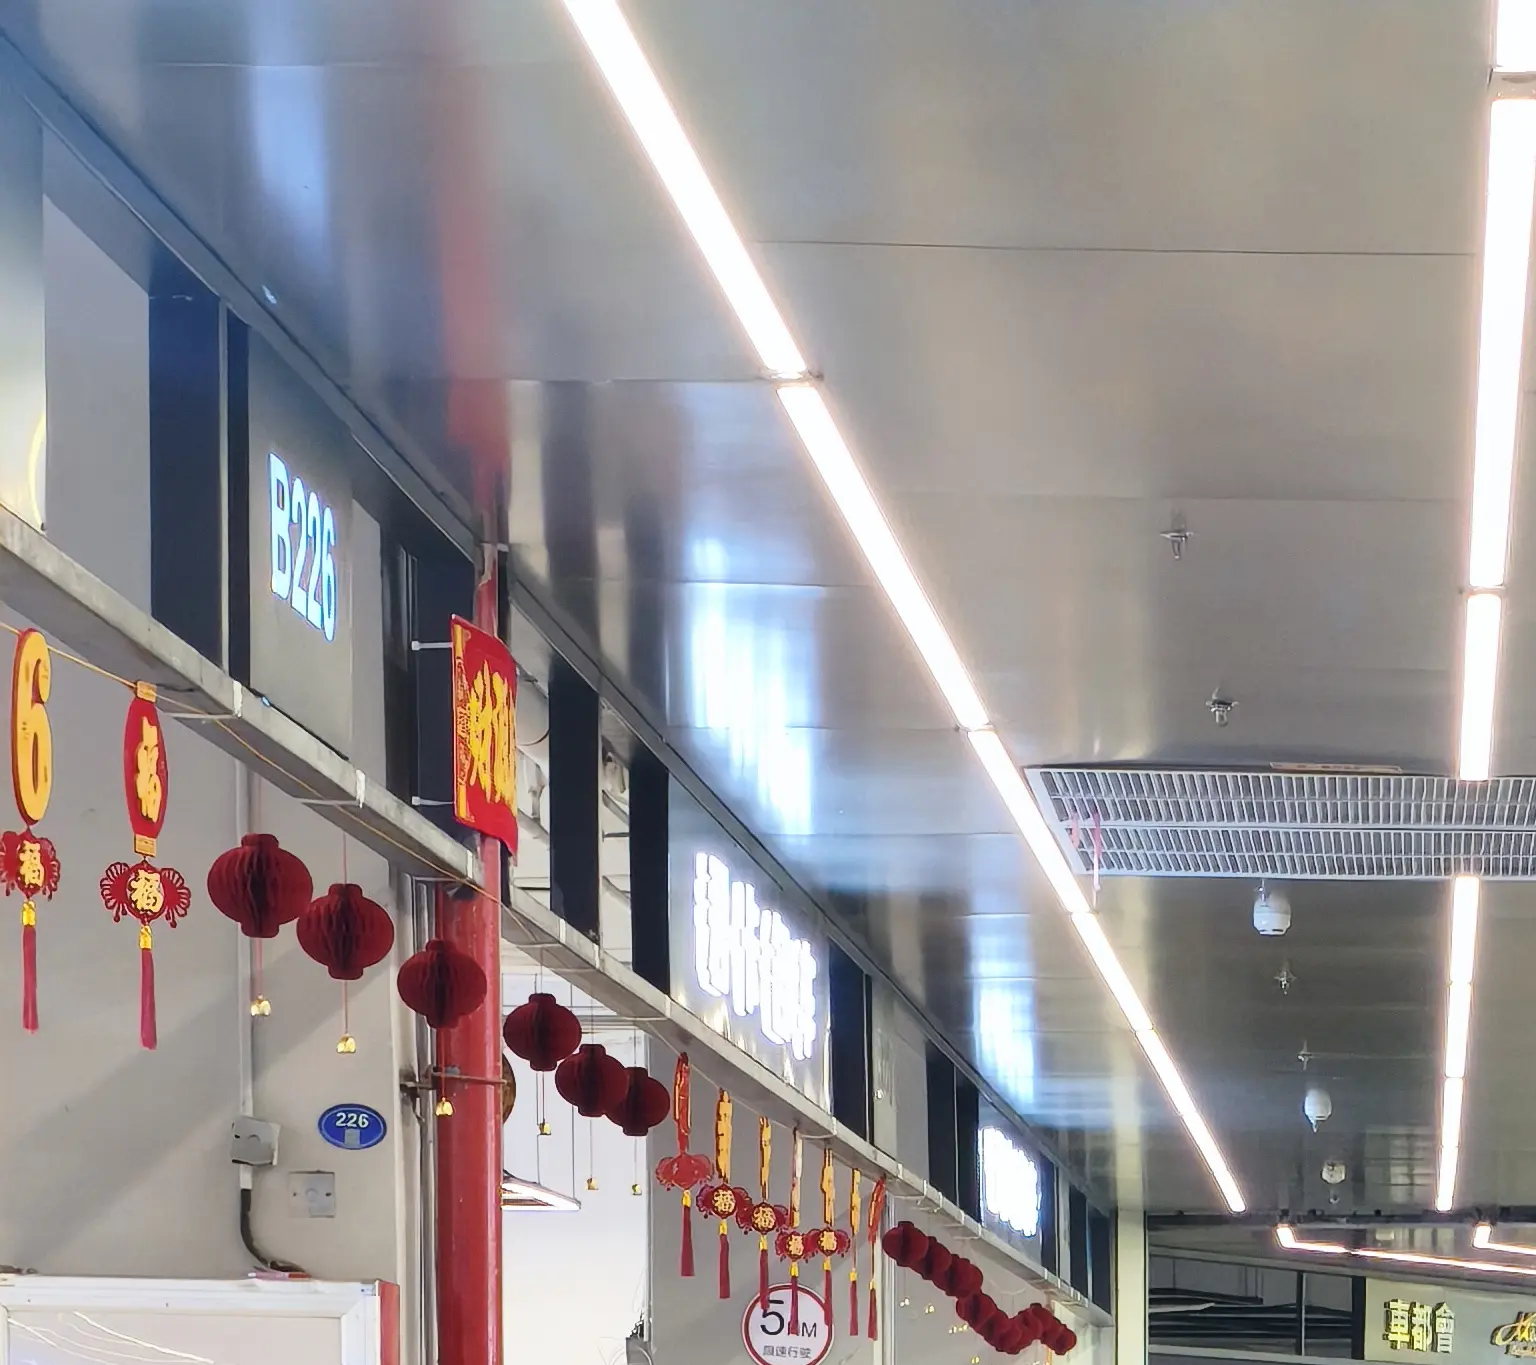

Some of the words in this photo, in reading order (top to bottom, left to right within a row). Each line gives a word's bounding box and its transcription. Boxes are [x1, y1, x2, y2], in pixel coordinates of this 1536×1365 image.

[269, 453, 336, 642] B226
[11, 628, 52, 824] 6
[335, 1112, 369, 1129] 226
[713, 1190, 735, 1213] 福
[753, 1206, 775, 1229] 福
[760, 1299, 817, 1338] 5M
